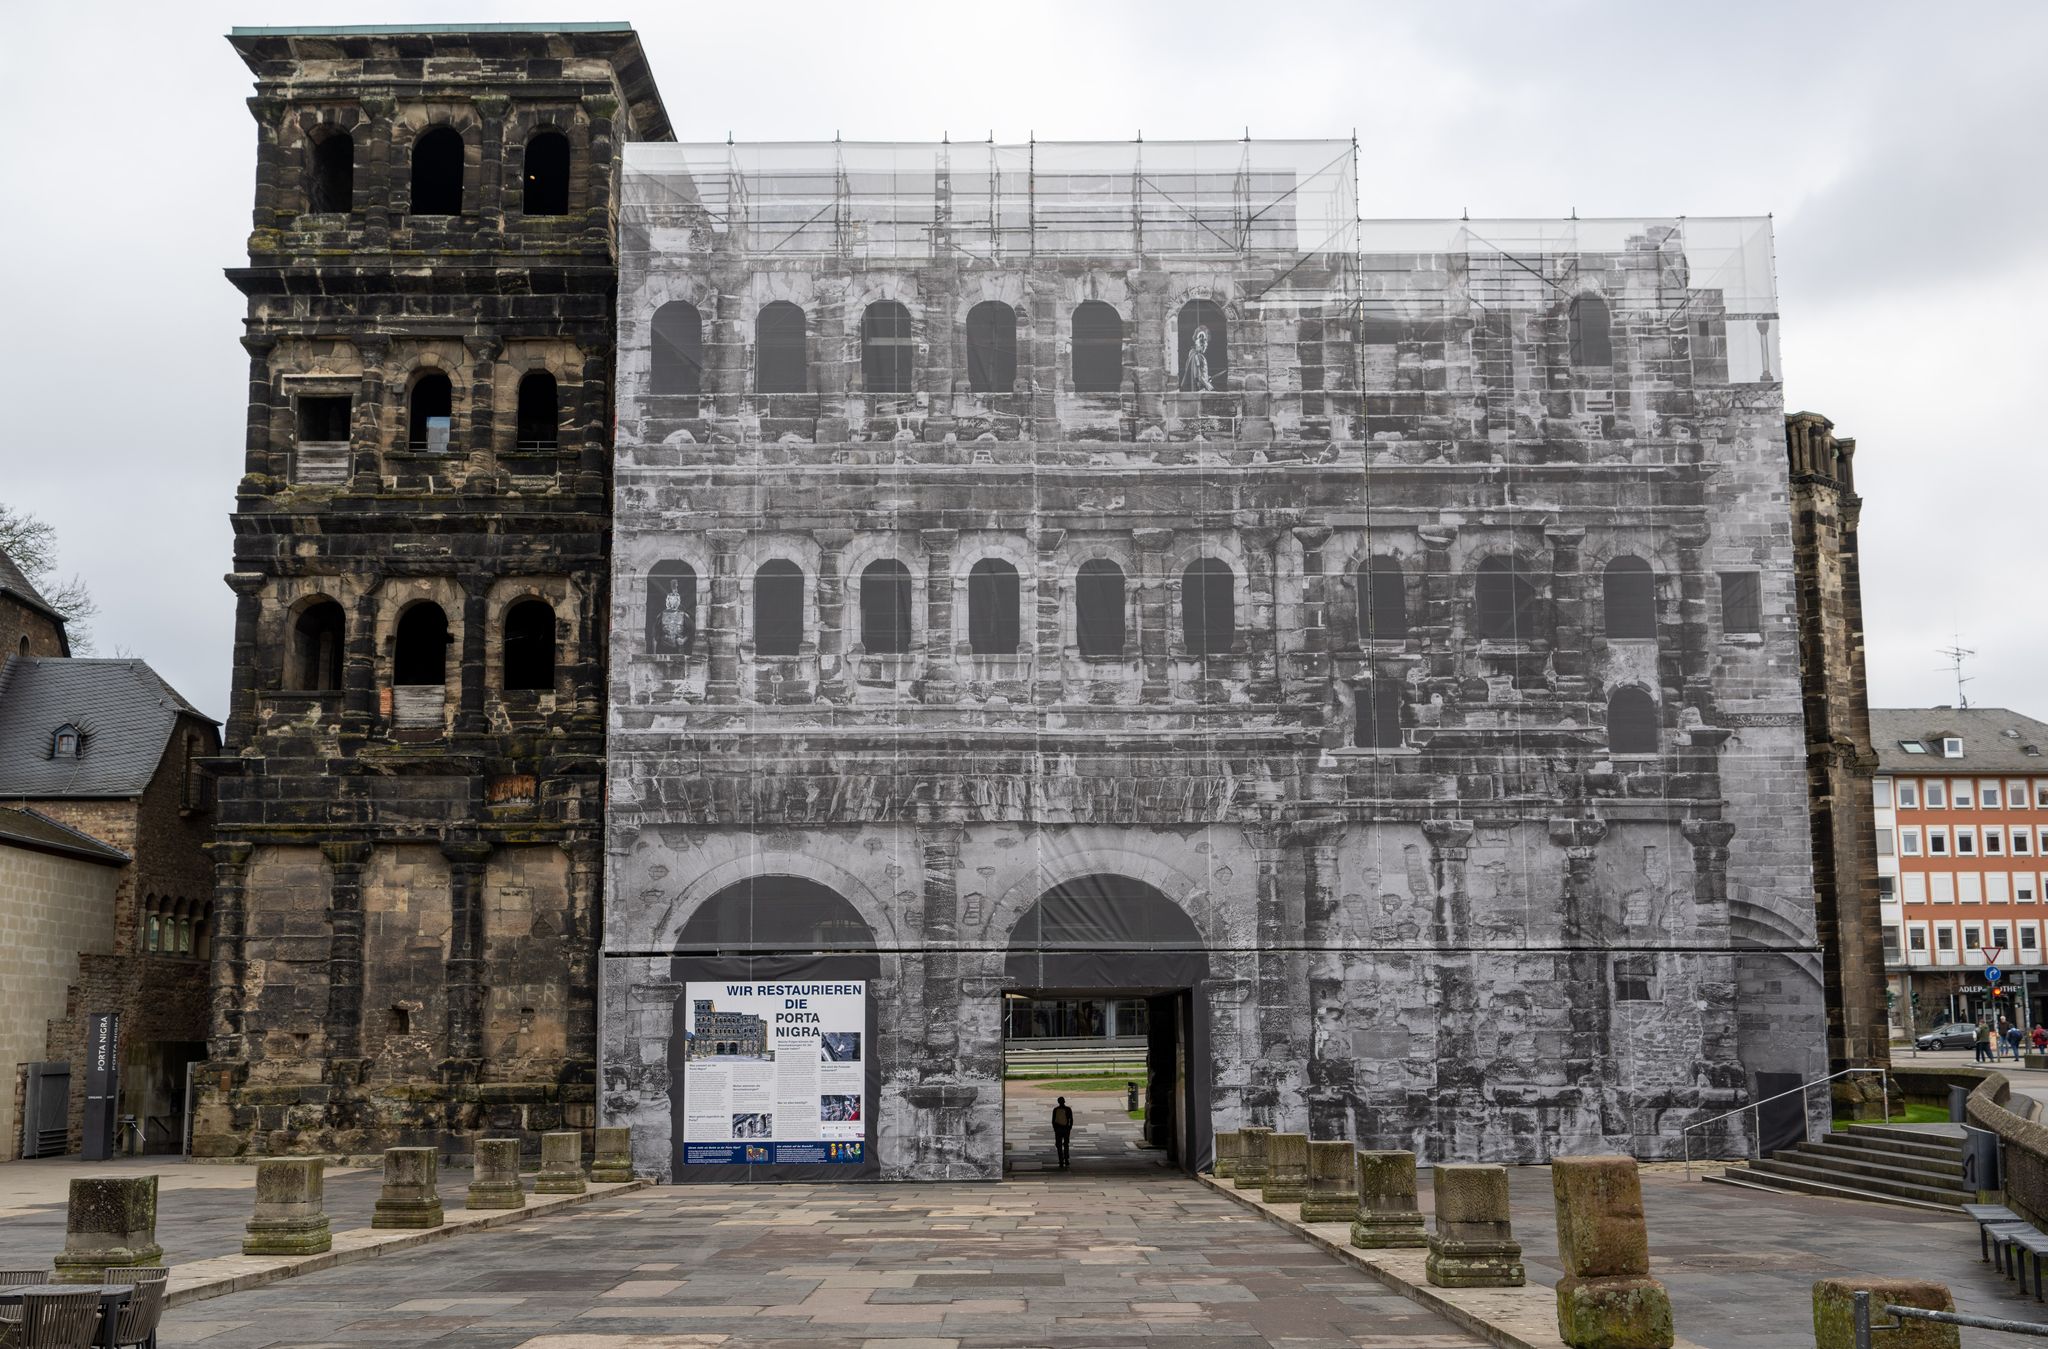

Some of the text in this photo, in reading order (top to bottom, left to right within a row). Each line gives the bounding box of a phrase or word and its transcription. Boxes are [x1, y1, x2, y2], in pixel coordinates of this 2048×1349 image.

[727, 985, 861, 996] WIR RESTAURIEREN
[785, 999, 807, 1009] DIE
[776, 1013, 820, 1023] PORTA
[776, 1027, 820, 1037] NIGRA
[97, 1017, 107, 1071] PORTA NIGRA
